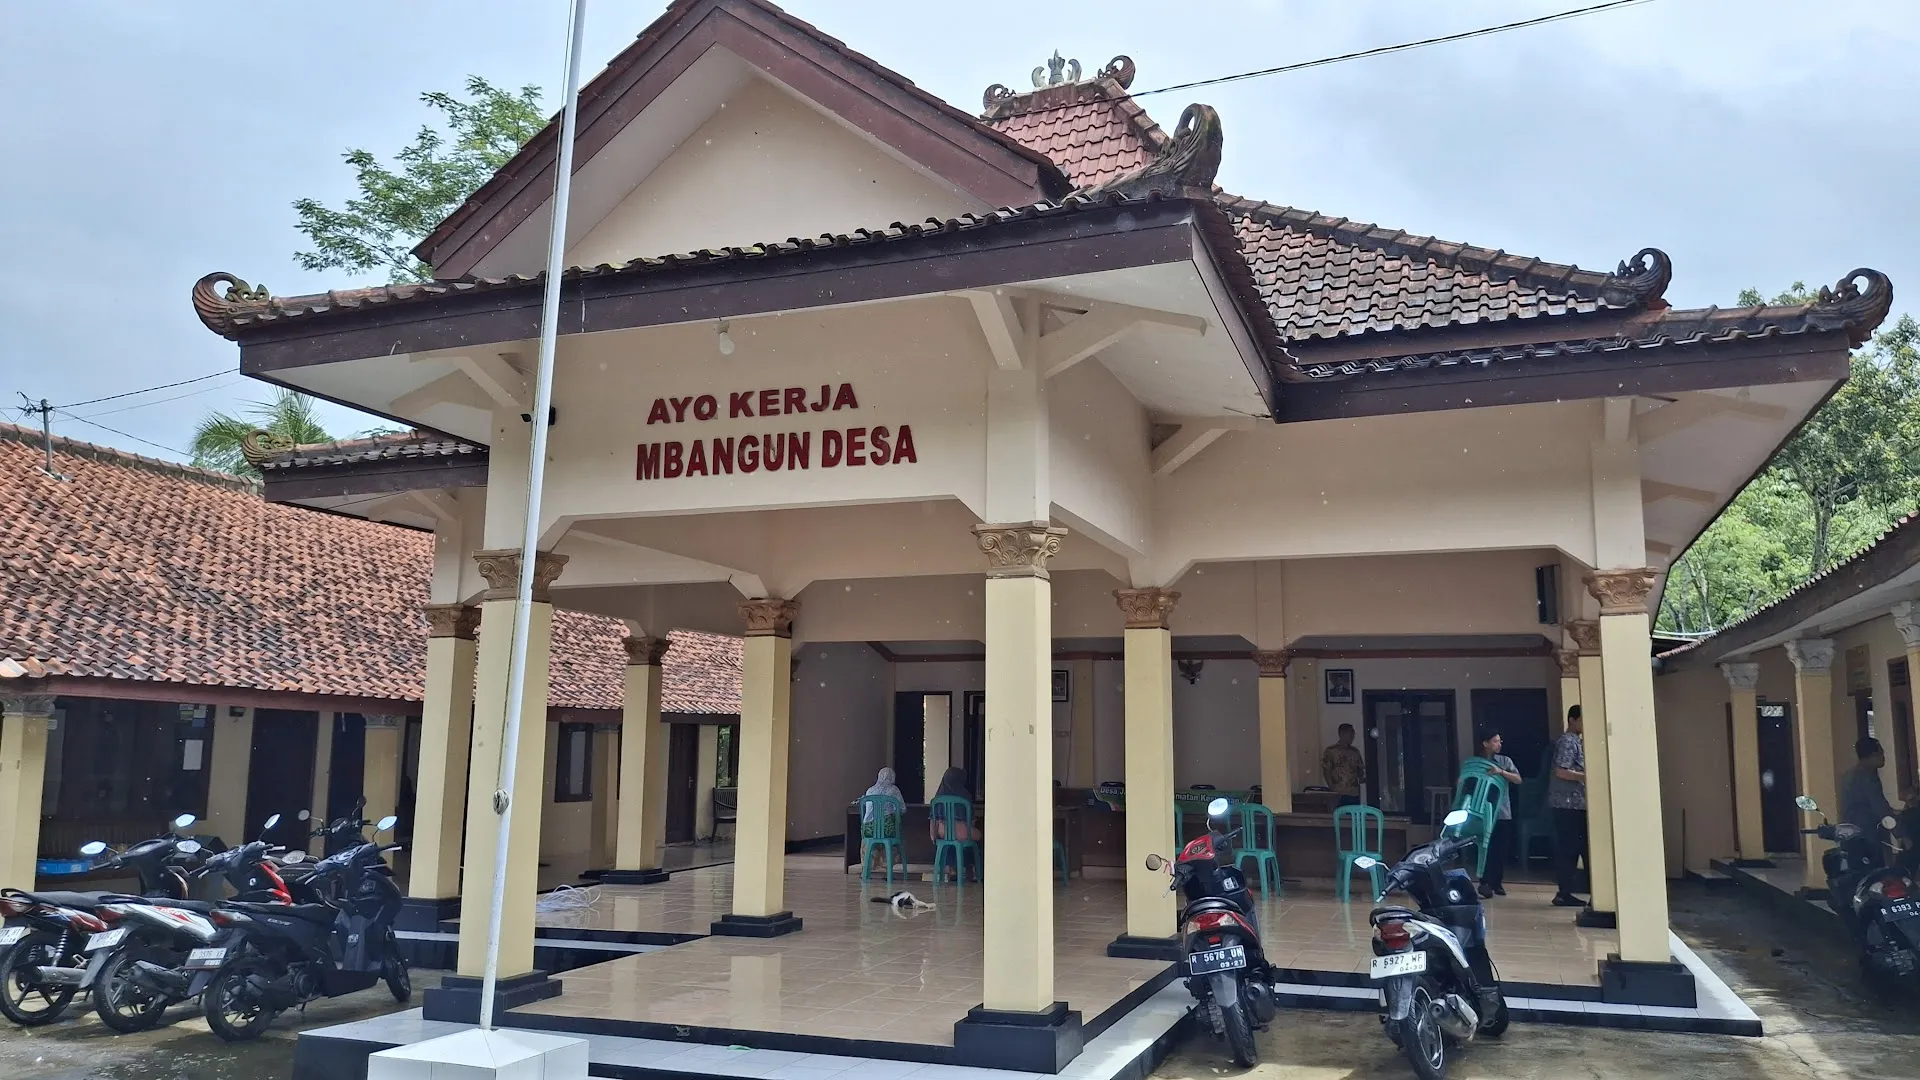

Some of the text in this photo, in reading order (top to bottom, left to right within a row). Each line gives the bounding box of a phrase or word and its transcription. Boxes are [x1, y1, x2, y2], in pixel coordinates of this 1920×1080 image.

[646, 383, 859, 425] AYO KERJA
[636, 425, 918, 481] MBANGUN DESA
[1175, 793, 1199, 801] matan
[1891, 903, 1912, 913] 6393
[1191, 947, 1243, 964] R 5676 UN
[1372, 959, 1378, 968] R
[1383, 955, 1405, 966] 6927
